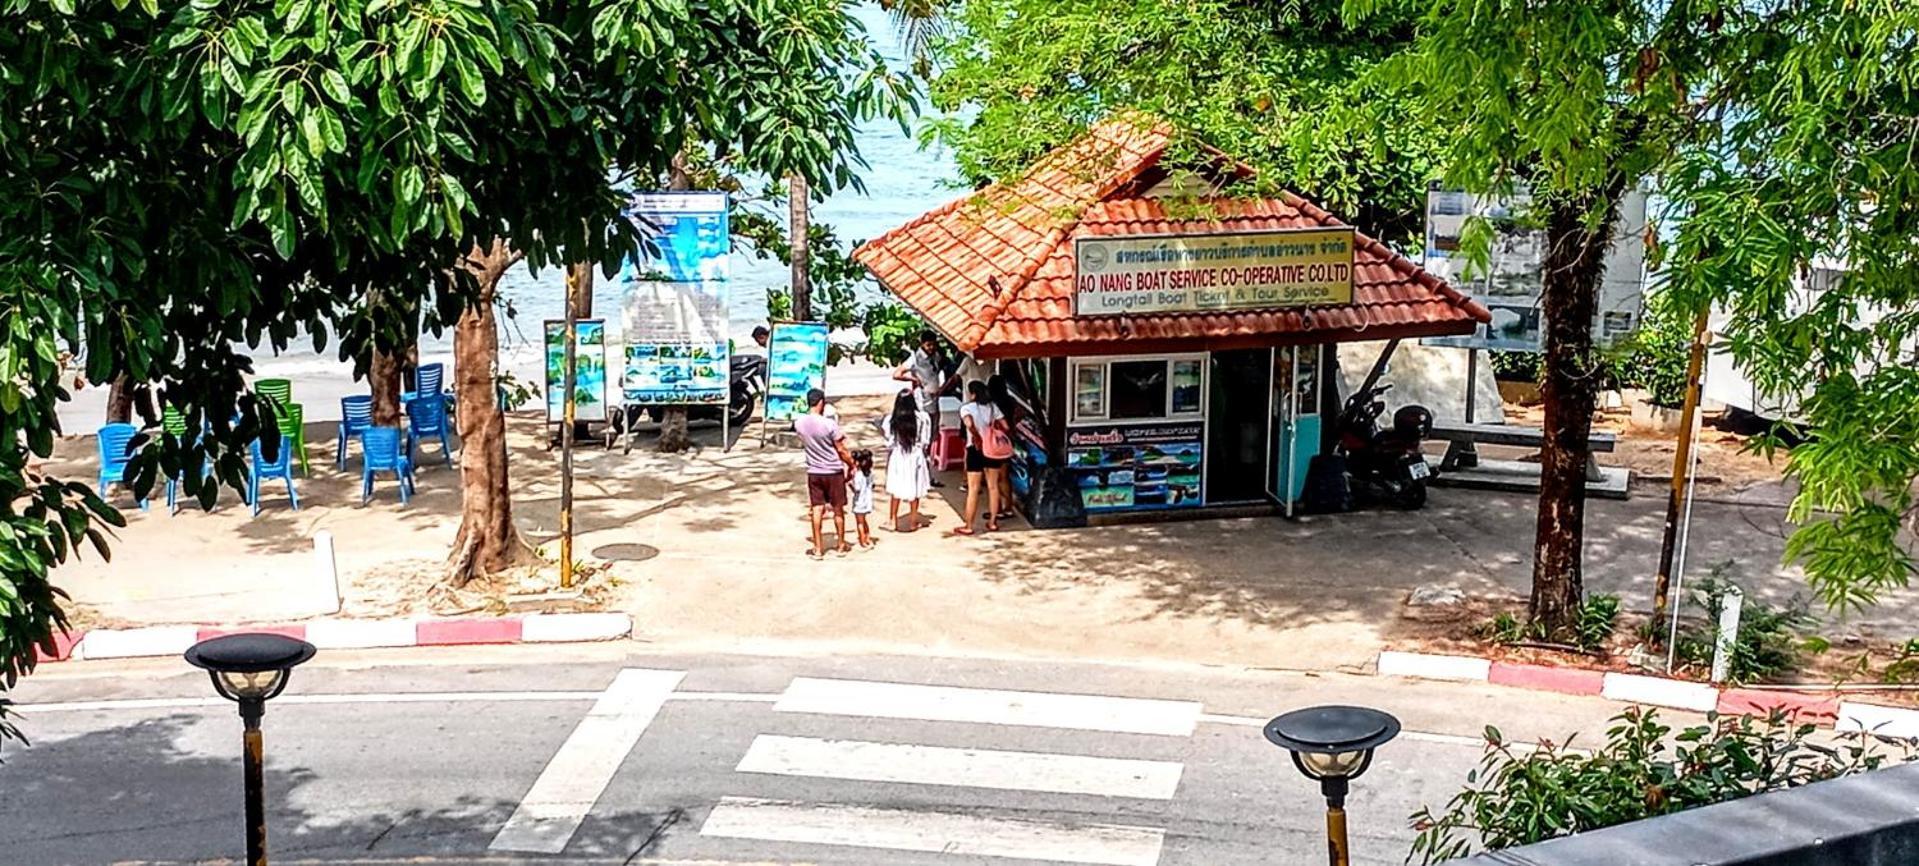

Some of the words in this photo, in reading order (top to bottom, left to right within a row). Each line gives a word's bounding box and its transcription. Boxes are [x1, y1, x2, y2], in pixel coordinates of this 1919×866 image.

[1079, 274, 1096, 293] AO
[1100, 272, 1132, 292] NANG
[1136, 271, 1167, 291] BOAT
[1169, 269, 1216, 289] SERVICE
[1221, 265, 1304, 286] CO-OPERATIVE
[1158, 292, 1187, 304] Boat
[1194, 289, 1229, 303] Ticket
[1235, 288, 1245, 299] &
[1252, 288, 1278, 299] Tour
[1284, 286, 1329, 298] Service
